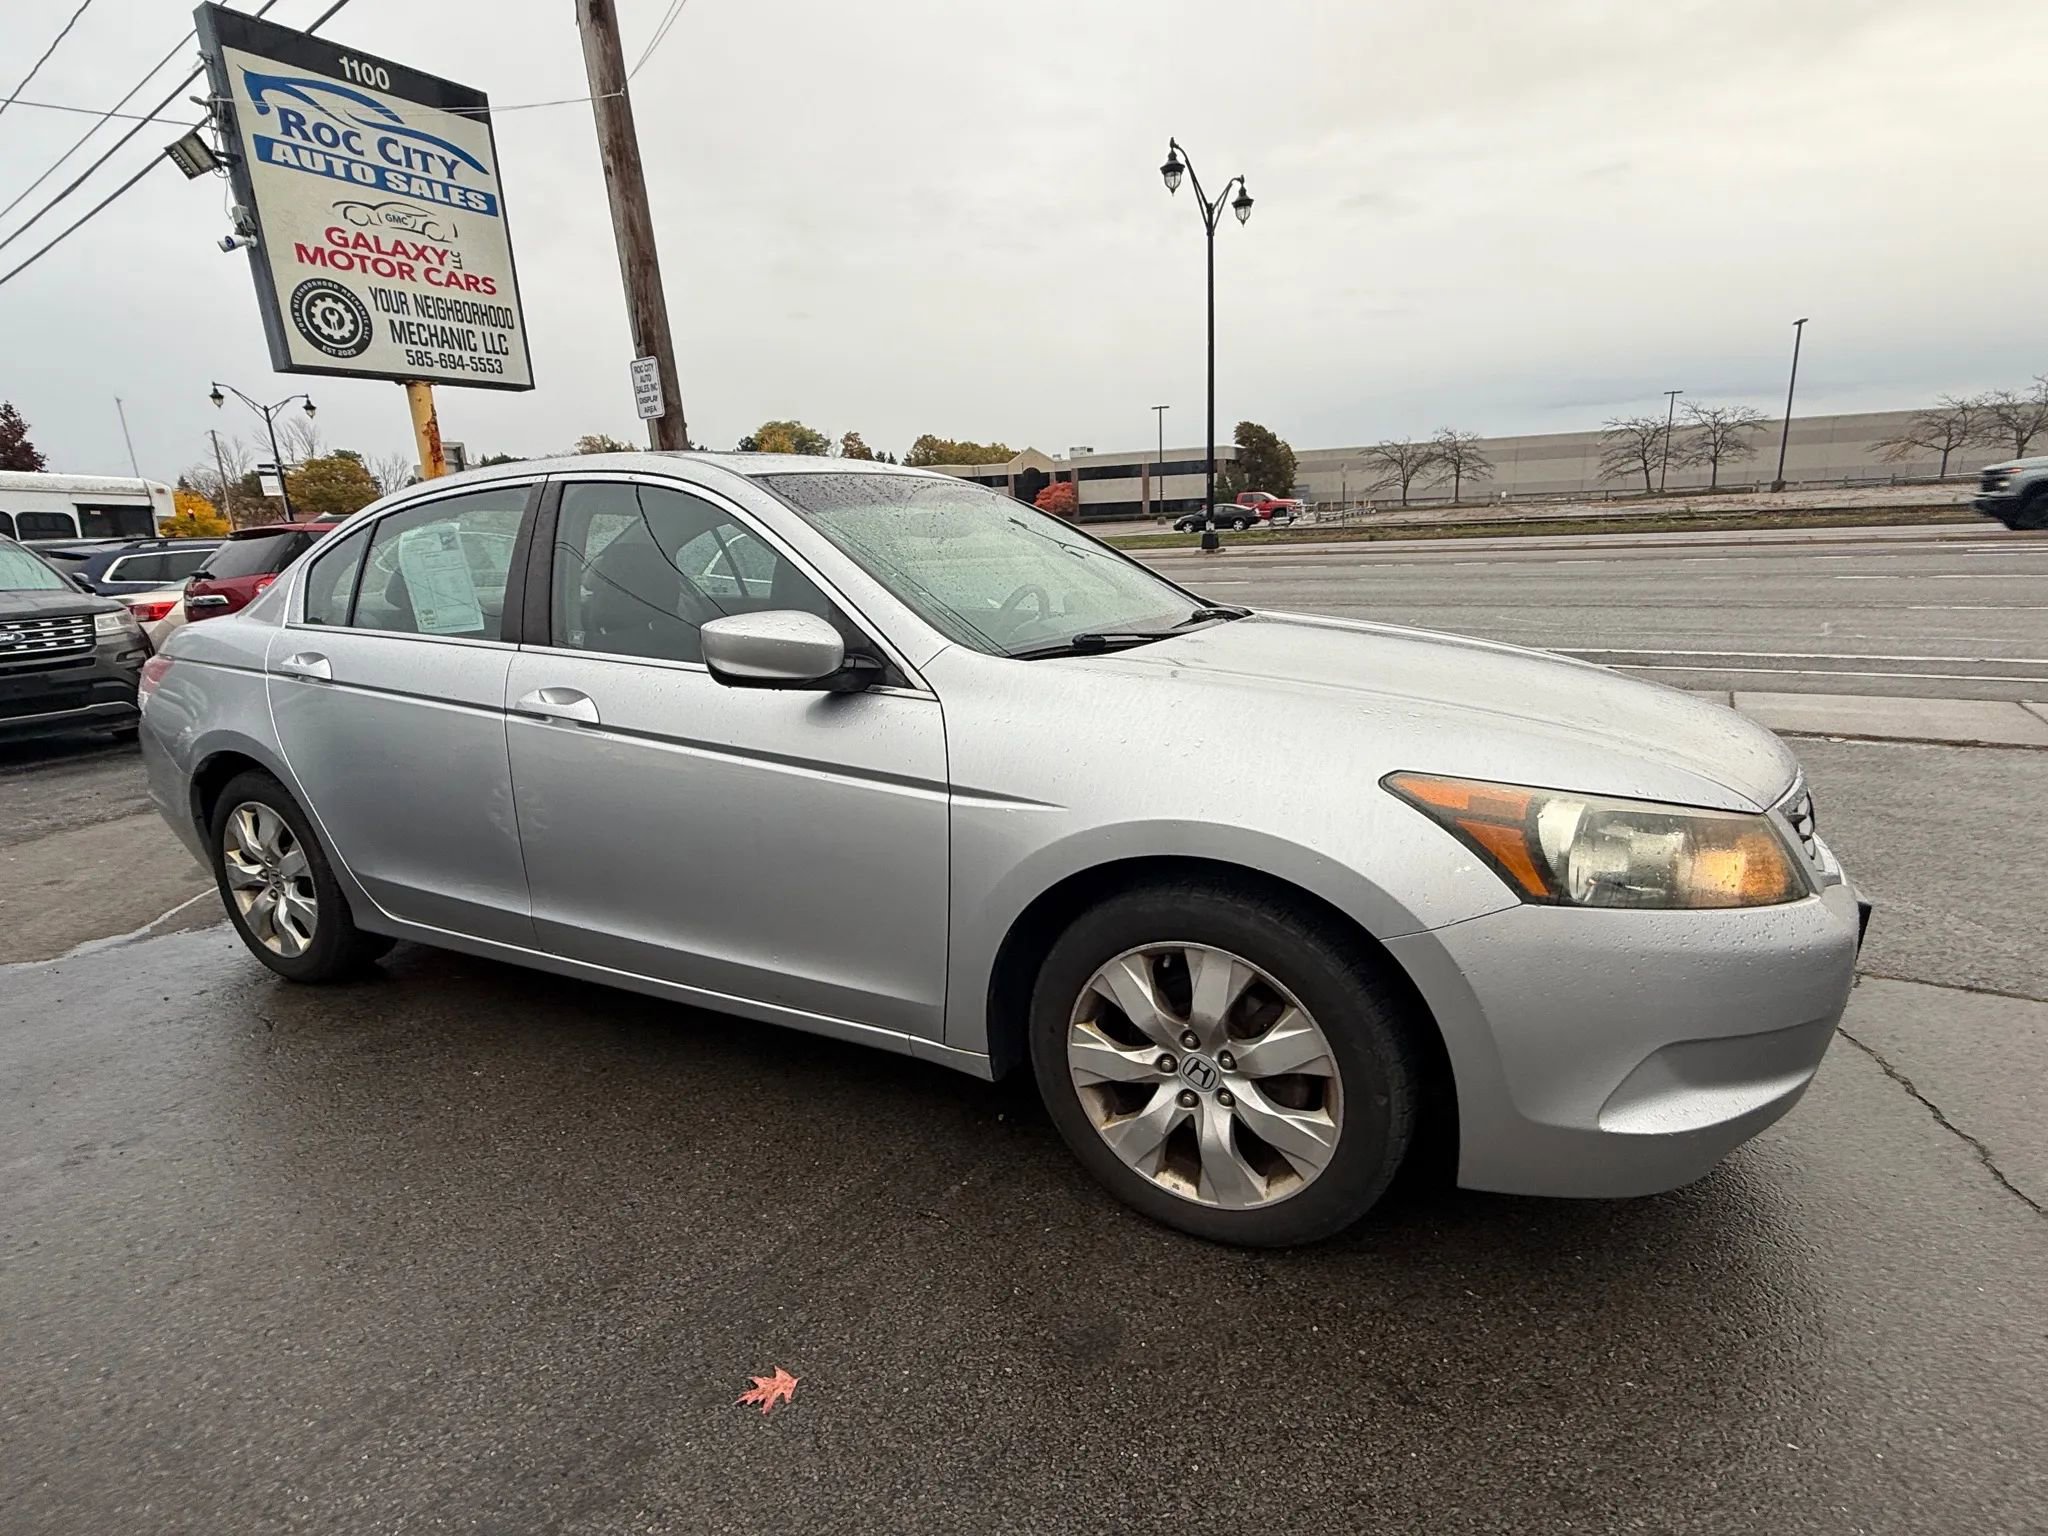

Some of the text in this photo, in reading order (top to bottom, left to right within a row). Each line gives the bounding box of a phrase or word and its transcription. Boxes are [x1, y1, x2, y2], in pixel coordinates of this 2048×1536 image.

[339, 56, 390, 90] 1100
[274, 104, 462, 180] ROC CITY
[271, 142, 488, 211] AUTO SALES
[385, 214, 408, 226] GMC
[294, 243, 497, 295] MOTOR CARS
[325, 226, 463, 270] GALAXY LLC
[368, 286, 515, 330] YOUR NEIGHBORHOOD
[389, 319, 509, 356] MECHANIC LLC
[405, 349, 504, 374] 585-694-5553
